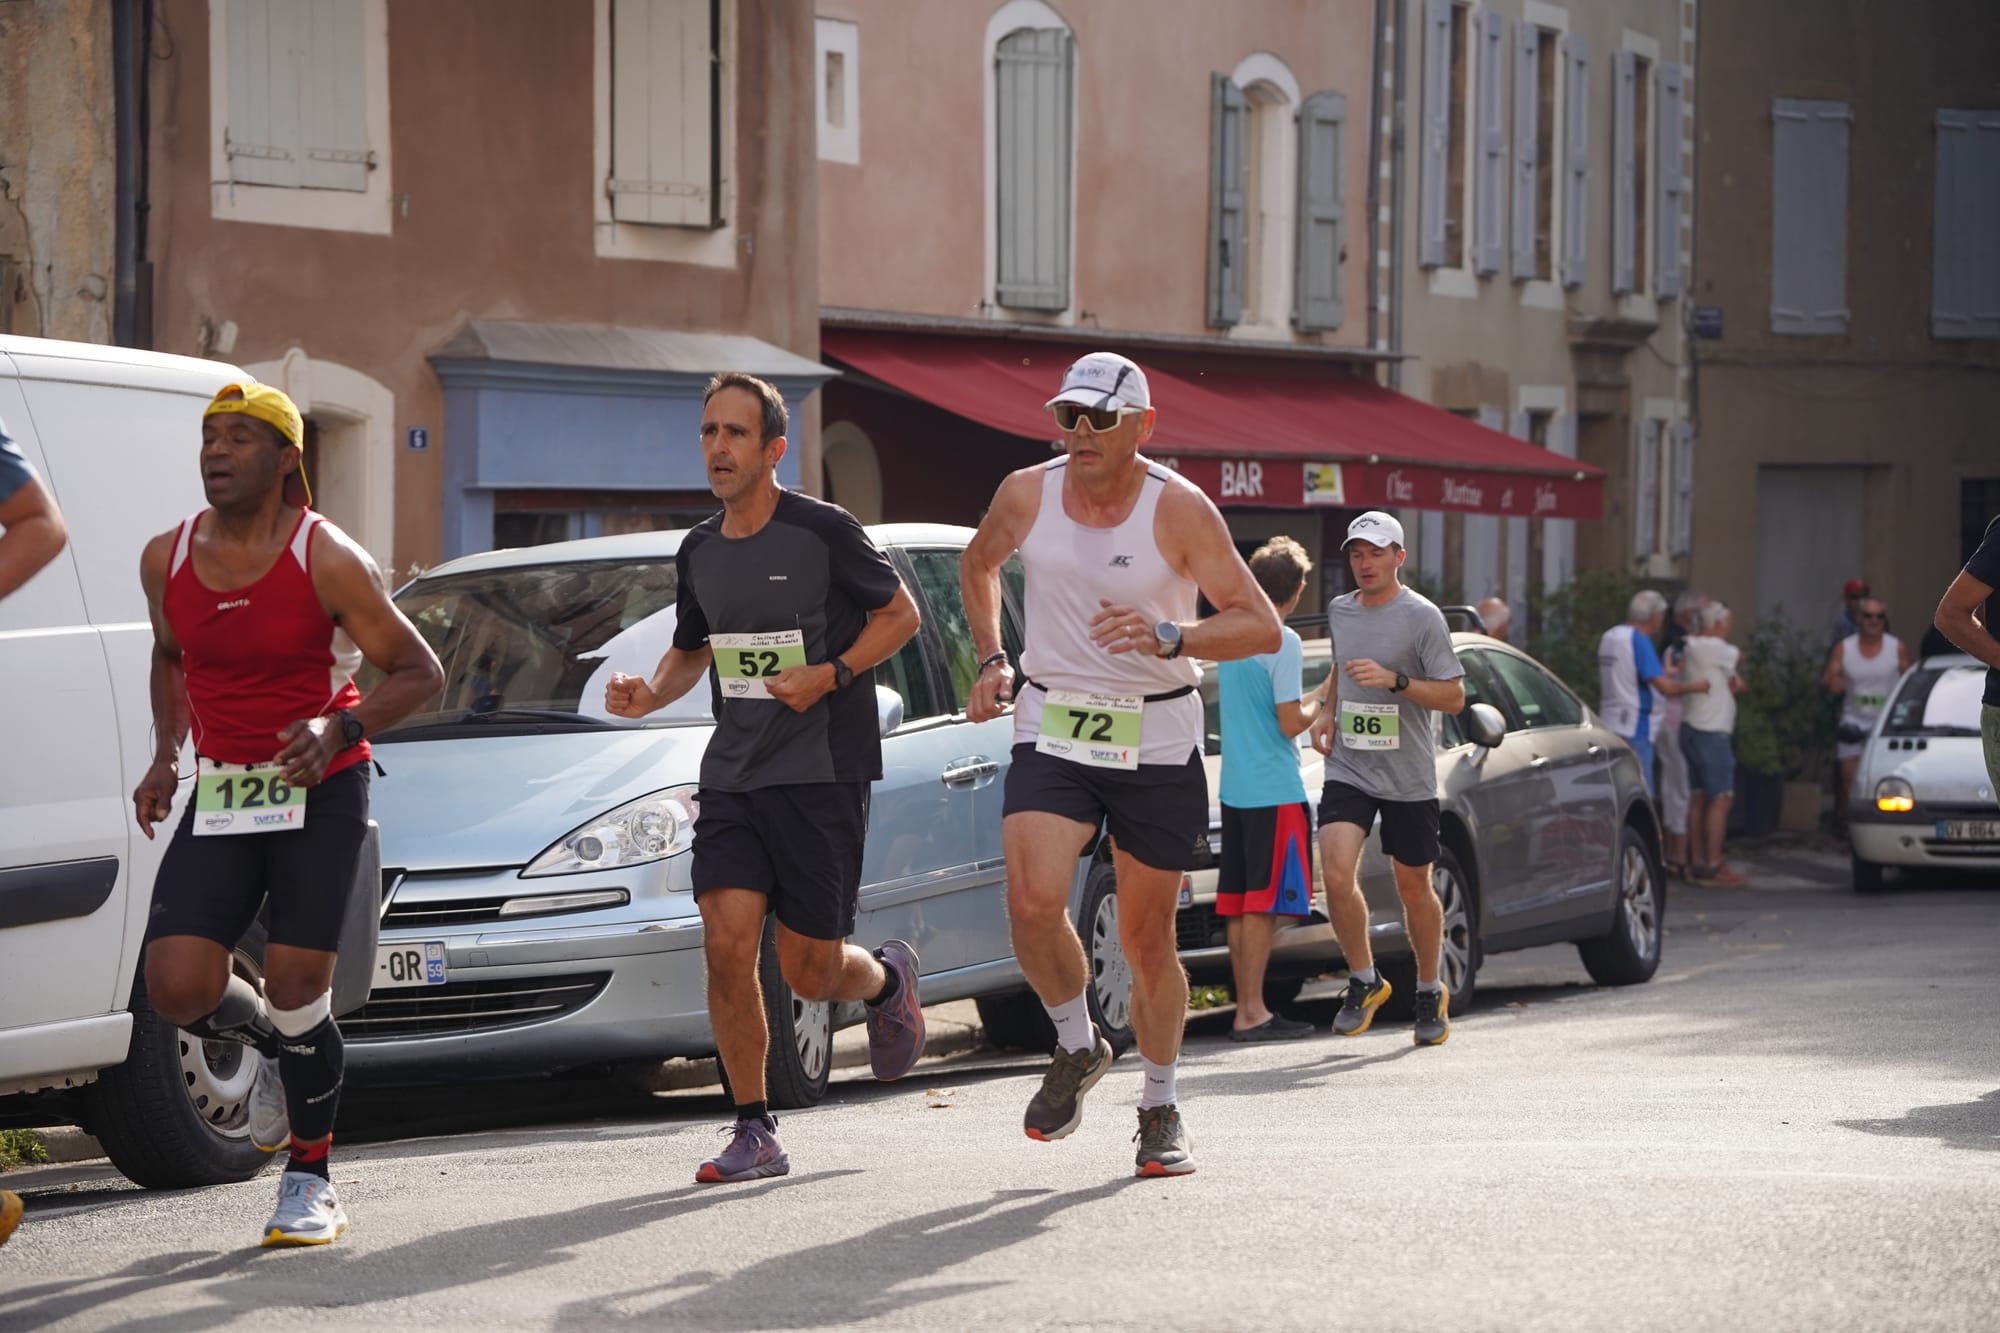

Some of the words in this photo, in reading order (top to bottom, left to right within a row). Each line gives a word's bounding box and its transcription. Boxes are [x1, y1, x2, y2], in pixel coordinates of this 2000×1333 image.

[1221, 461, 1264, 497] BAR
[739, 651, 781, 677] 52
[1068, 710, 1113, 742] 72
[1353, 716, 1381, 735] 86
[216, 776, 291, 809] 126
[428, 963, 443, 978] 59
